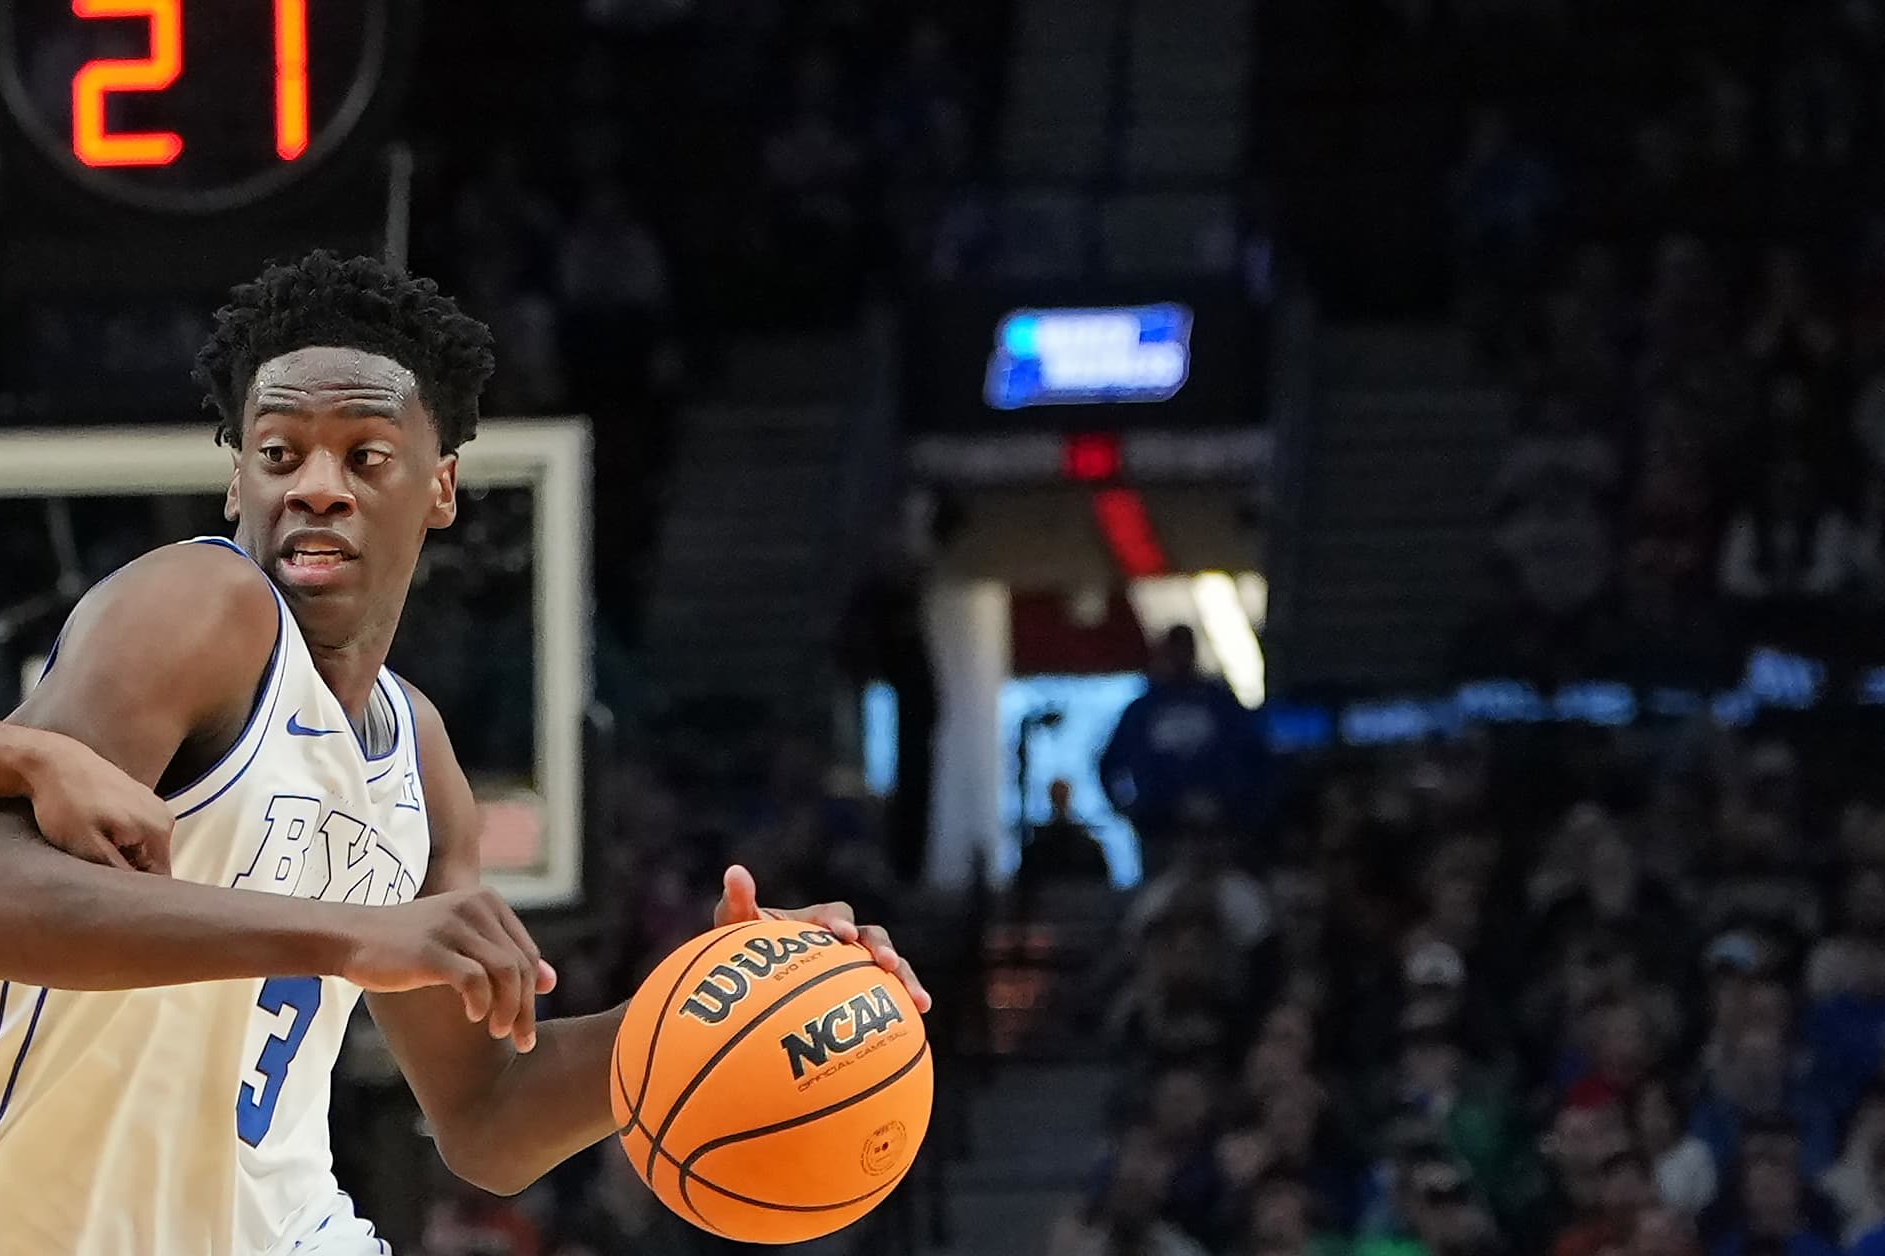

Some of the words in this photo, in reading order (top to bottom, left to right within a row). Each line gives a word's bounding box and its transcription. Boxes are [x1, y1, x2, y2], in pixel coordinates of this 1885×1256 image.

[72, 0, 309, 167] 21
[678, 930, 837, 1025] Wilso
[773, 963, 799, 982] EVO
[236, 976, 323, 1148] 3
[780, 984, 904, 1081] NCAA
